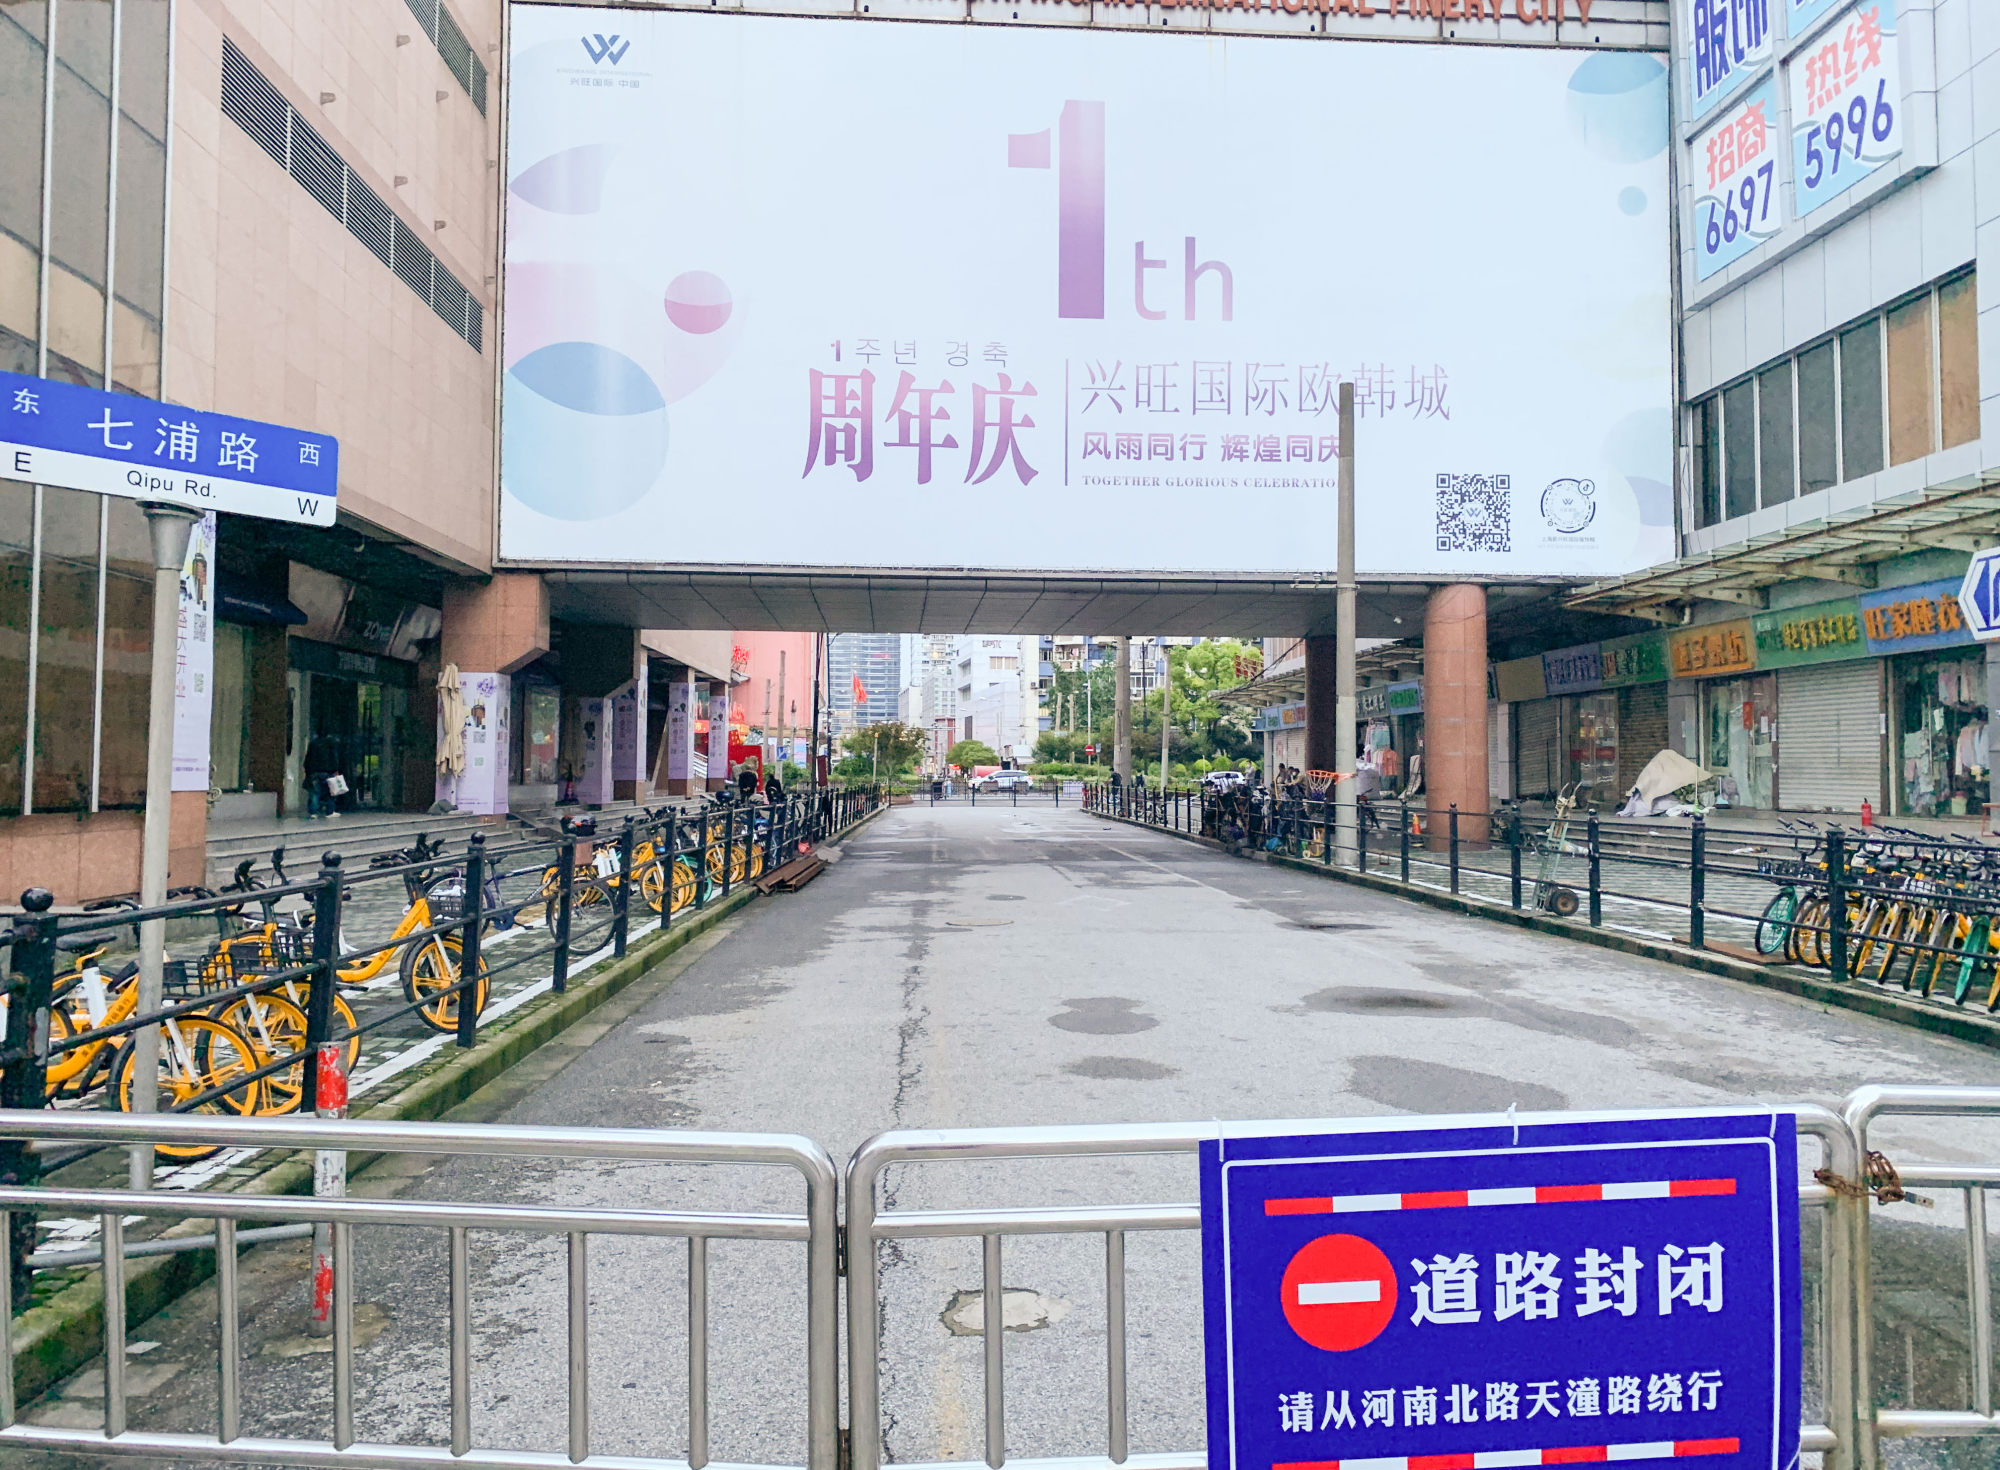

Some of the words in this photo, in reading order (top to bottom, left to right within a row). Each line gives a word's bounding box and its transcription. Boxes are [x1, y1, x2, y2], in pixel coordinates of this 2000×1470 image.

[1706, 99, 1767, 191] 招商
[1804, 6, 1882, 117] 热线
[1705, 159, 1774, 256] 6697
[1804, 78, 1894, 189] 5996
[830, 338, 917, 366] 1주년
[945, 340, 1009, 369] 경축
[12, 388, 41, 415] 东
[1080, 358, 1451, 422] 兴旺国际欧韩城
[87, 407, 260, 474] 七浦路
[801, 367, 1039, 486] 周年庆
[14, 451, 32, 473] E
[298, 441, 322, 467] 西
[1081, 431, 1208, 462] 风雨同行
[1220, 433, 1340, 463] 辉煌同庆
[126, 470, 174, 492] Qipu
[185, 479, 217, 499] Rd.
[1081, 475, 1161, 488] TOGETHER
[1165, 476, 1239, 488] GLORIOUS
[296, 497, 320, 518] W
[1409, 1241, 1725, 1328] 道路封闭
[1278, 1369, 1723, 1433] 请从河南北路天潼路绕行
